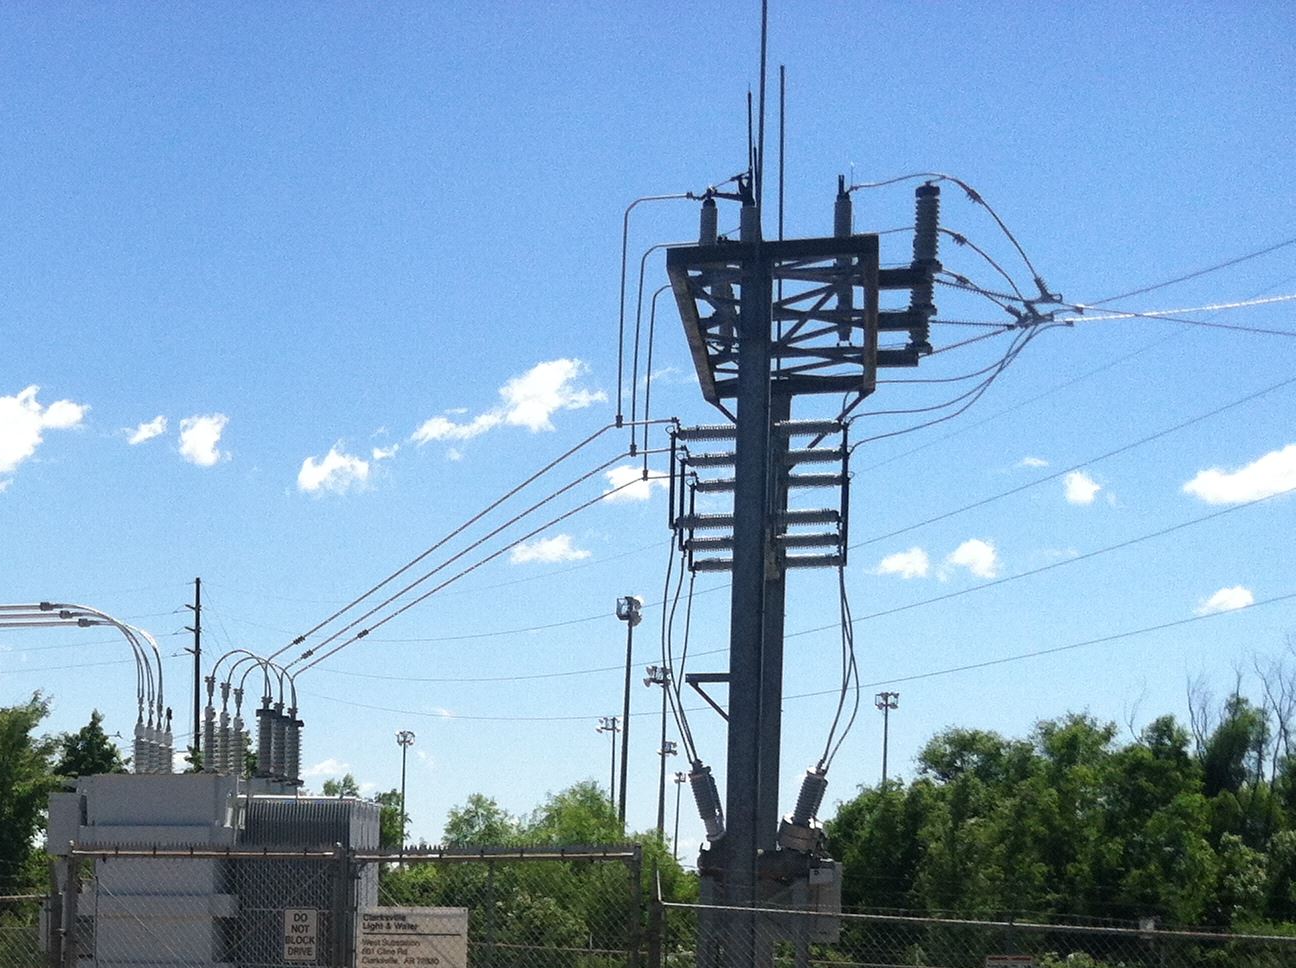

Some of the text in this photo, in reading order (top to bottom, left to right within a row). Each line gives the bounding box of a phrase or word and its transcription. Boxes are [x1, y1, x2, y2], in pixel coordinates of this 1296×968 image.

[293, 913, 308, 922] DO
[290, 924, 310, 934] NOT
[363, 922, 418, 931] Light & Water
[285, 935, 315, 945] BLOCK
[287, 947, 313, 956] DRIVE
